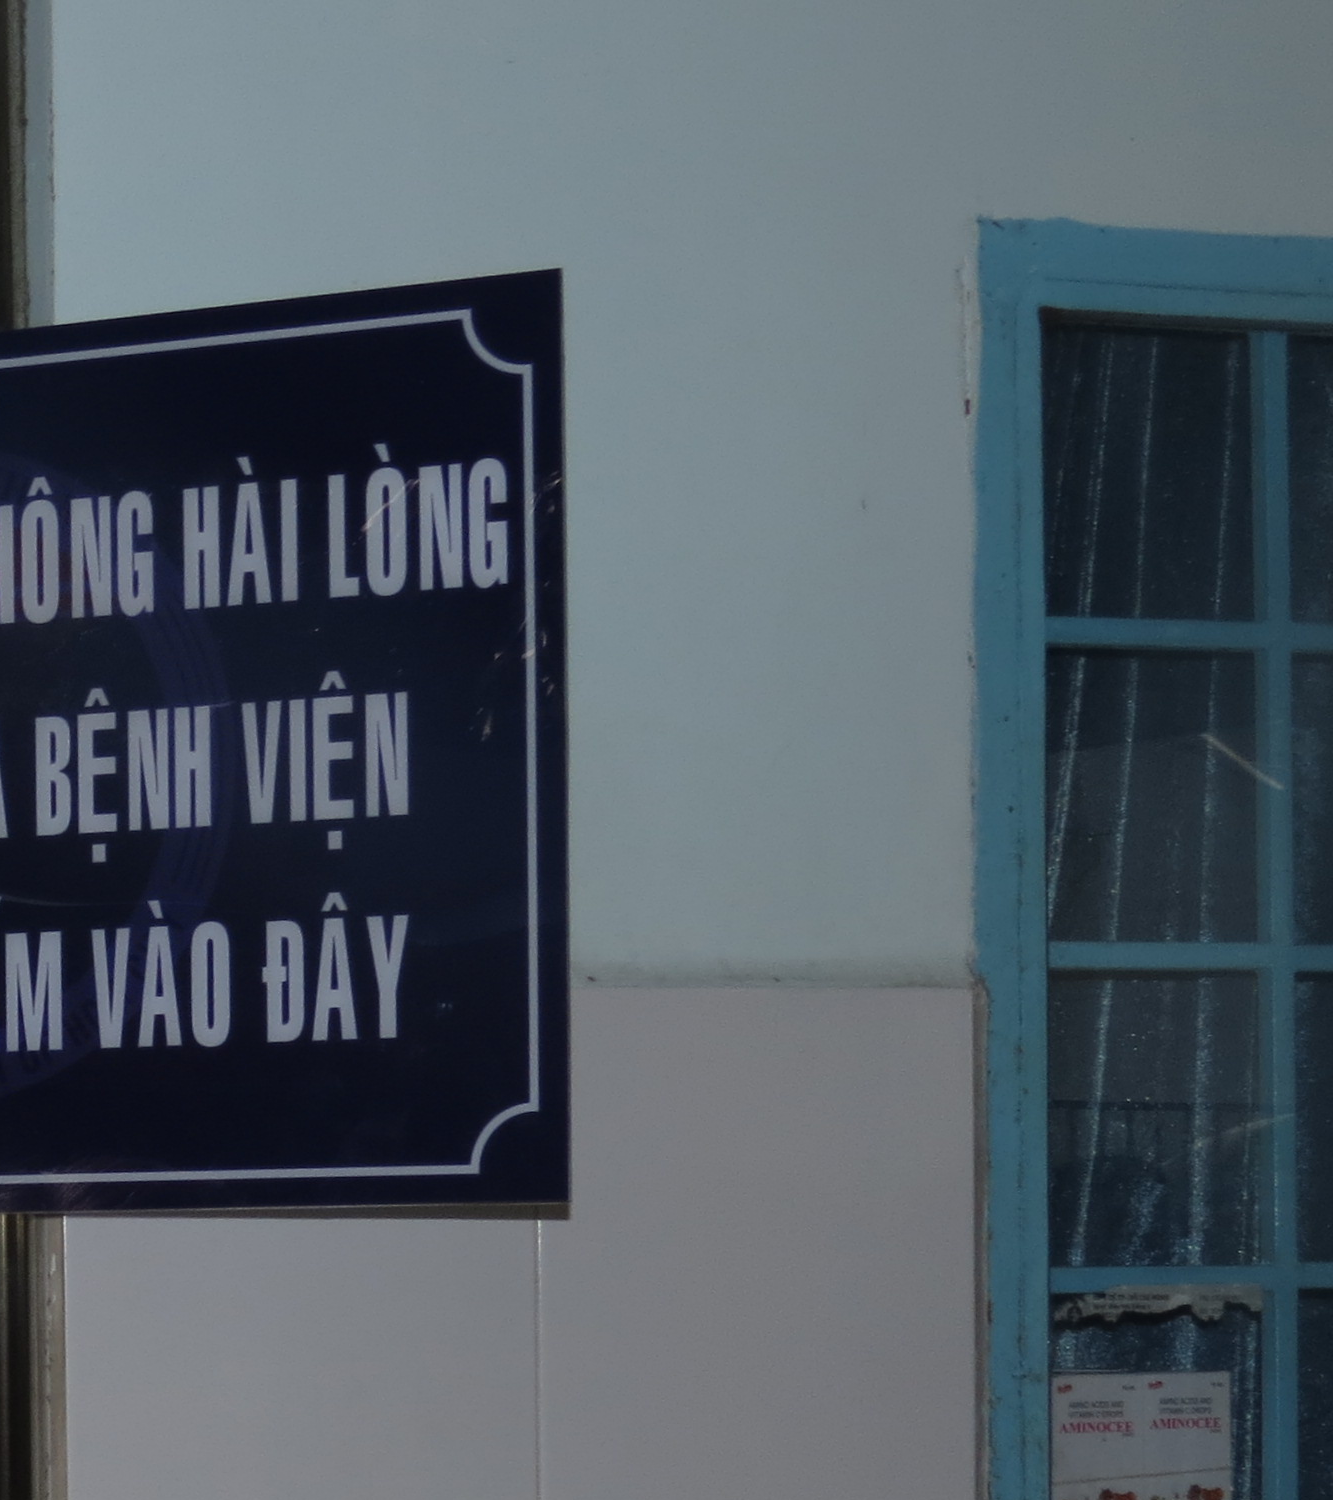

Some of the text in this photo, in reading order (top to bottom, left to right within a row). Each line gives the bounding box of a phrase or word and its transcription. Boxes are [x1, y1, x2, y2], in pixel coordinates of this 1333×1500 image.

[183, 456, 298, 610] HÀI
[328, 443, 510, 598] LÒNG
[35, 688, 212, 863] BỆNH
[242, 670, 409, 850] VIỆN
[91, 900, 231, 1050] VÀO
[261, 892, 409, 1044] ĐÂY
[1060, 1421, 1133, 1433] AMINOCEE
[1150, 1417, 1221, 1429] AMINOCEE
